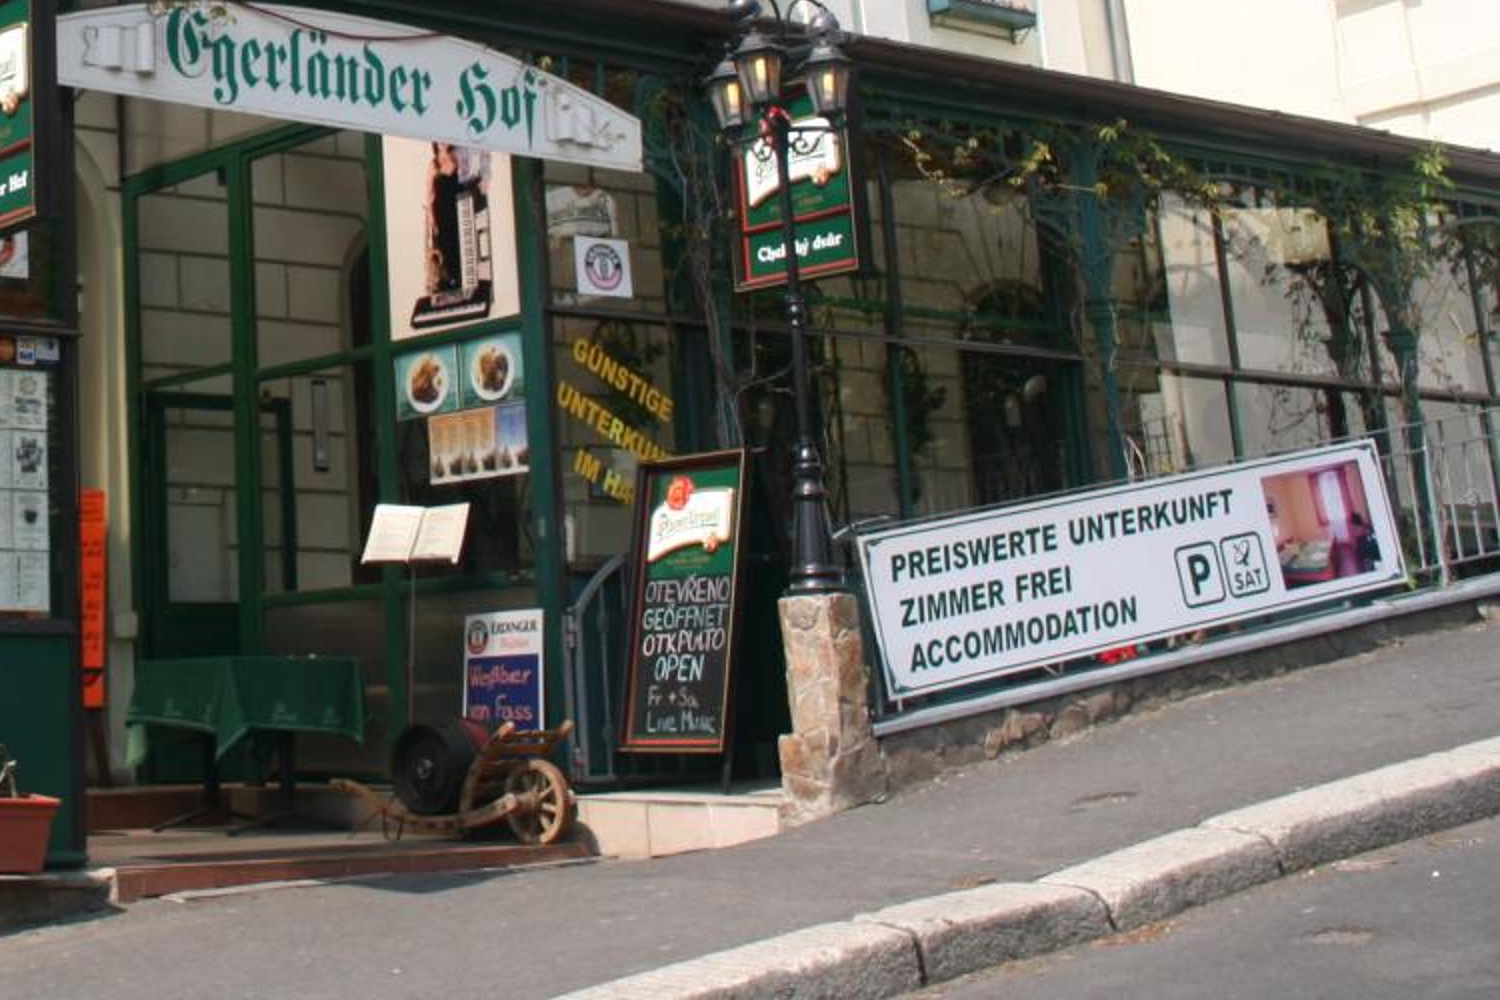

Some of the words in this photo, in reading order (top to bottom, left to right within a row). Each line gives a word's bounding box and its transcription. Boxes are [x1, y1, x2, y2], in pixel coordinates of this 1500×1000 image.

[166, 3, 432, 117] Egerländer
[456, 60, 539, 148] Hof
[574, 448, 600, 484] IM
[890, 523, 1059, 583] PREISWERTE
[1068, 488, 1233, 546] UNTERKUNFT
[645, 574, 730, 604] OTEVŘENO
[1187, 553, 1211, 596] P
[1234, 567, 1263, 591] SAT
[900, 579, 1005, 628] ZIMMER
[1015, 565, 1073, 602] FREI
[643, 603, 729, 632] GEÖFFNET
[909, 596, 1138, 673] ACCOMMODATION
[654, 652, 707, 682] OPEN
